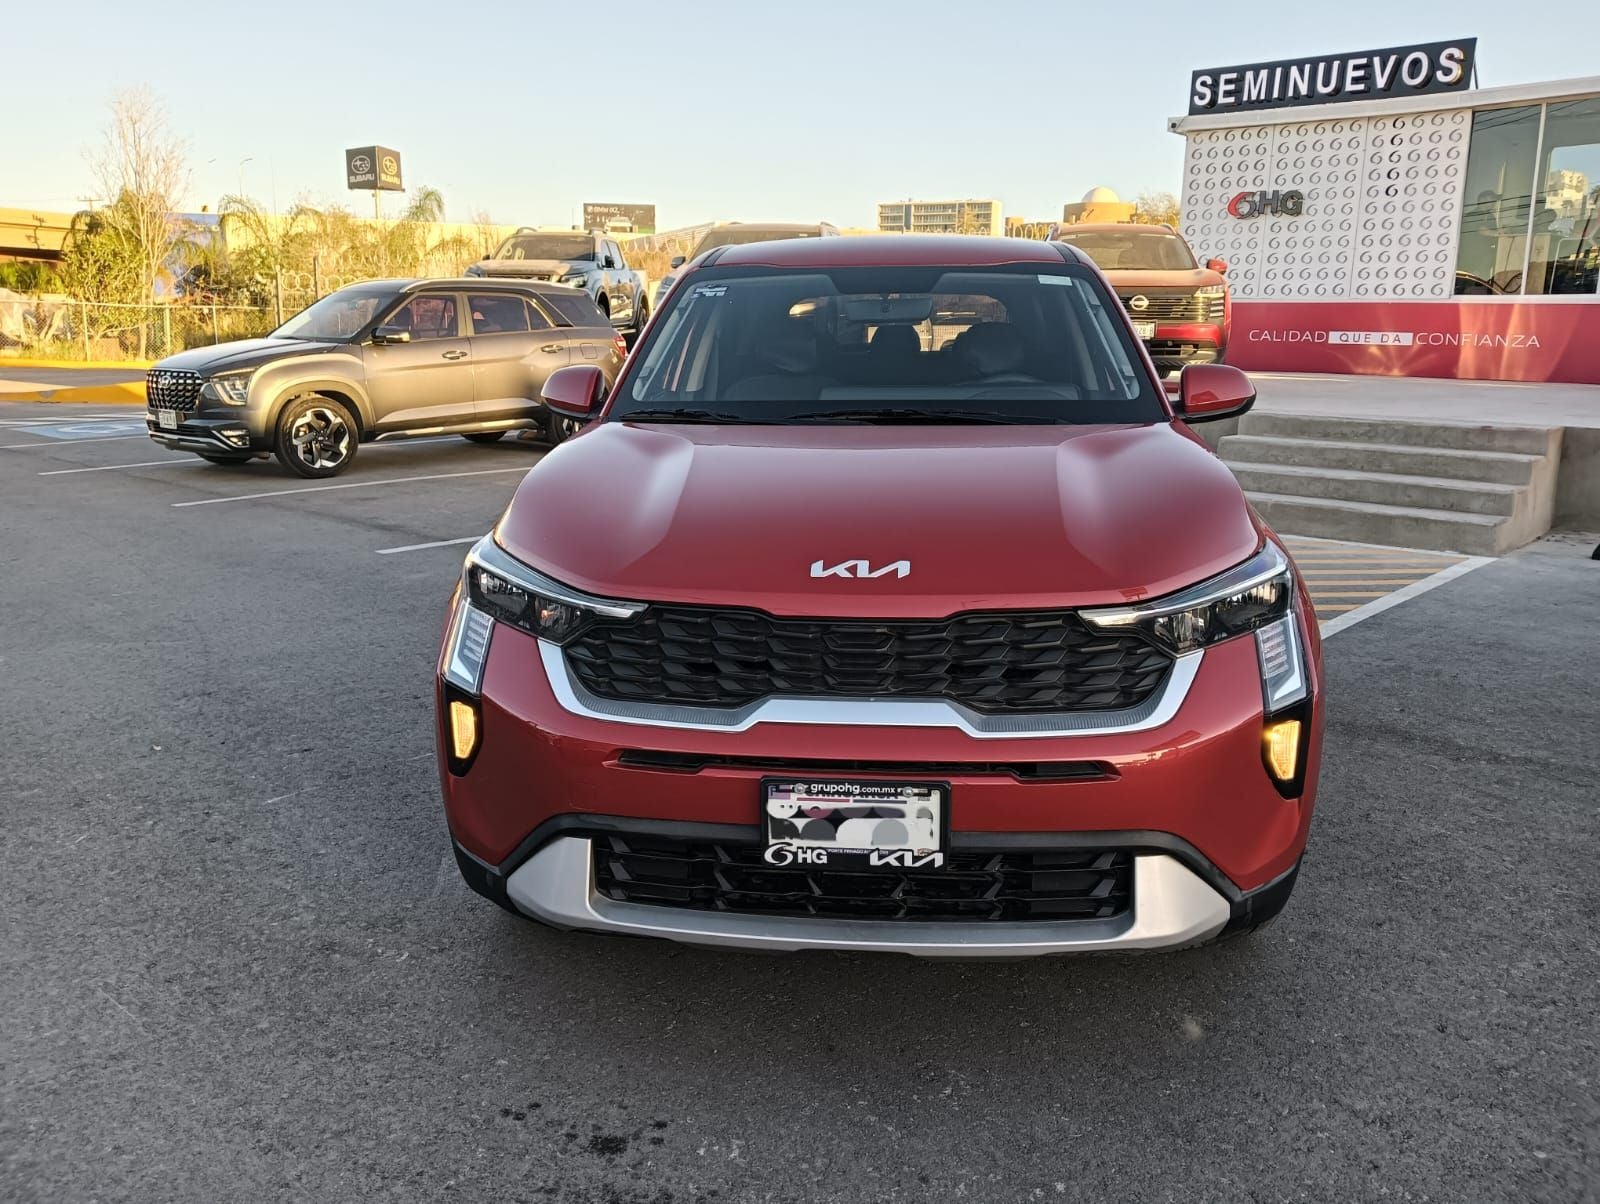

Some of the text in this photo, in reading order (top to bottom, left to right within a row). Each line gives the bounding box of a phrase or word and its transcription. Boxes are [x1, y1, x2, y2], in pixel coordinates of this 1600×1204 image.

[1193, 47, 1464, 107] SEMINUEVOS
[349, 173, 375, 183] SUBARU
[1249, 329, 1540, 348] CALIDAD QUE DA CONFIANZA
[810, 782, 896, 794] grupohg.com.mx
